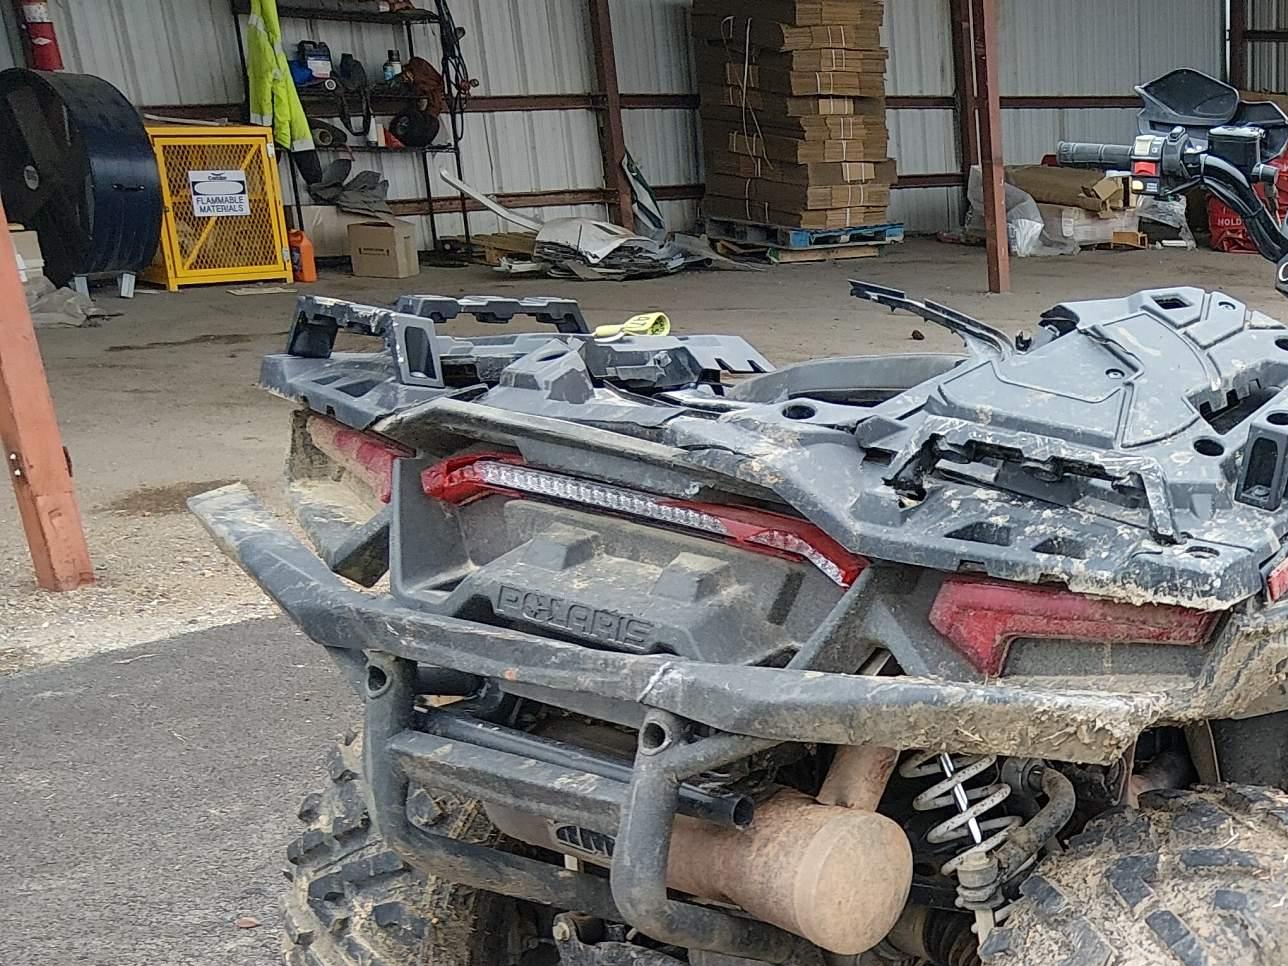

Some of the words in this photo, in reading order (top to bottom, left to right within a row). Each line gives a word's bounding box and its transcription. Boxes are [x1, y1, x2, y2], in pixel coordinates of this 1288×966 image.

[196, 195, 244, 205] FLAMMABLE
[199, 204, 244, 213] MATERIALS
[1217, 217, 1243, 227] HOLD
[498, 585, 655, 649] POLARIS
